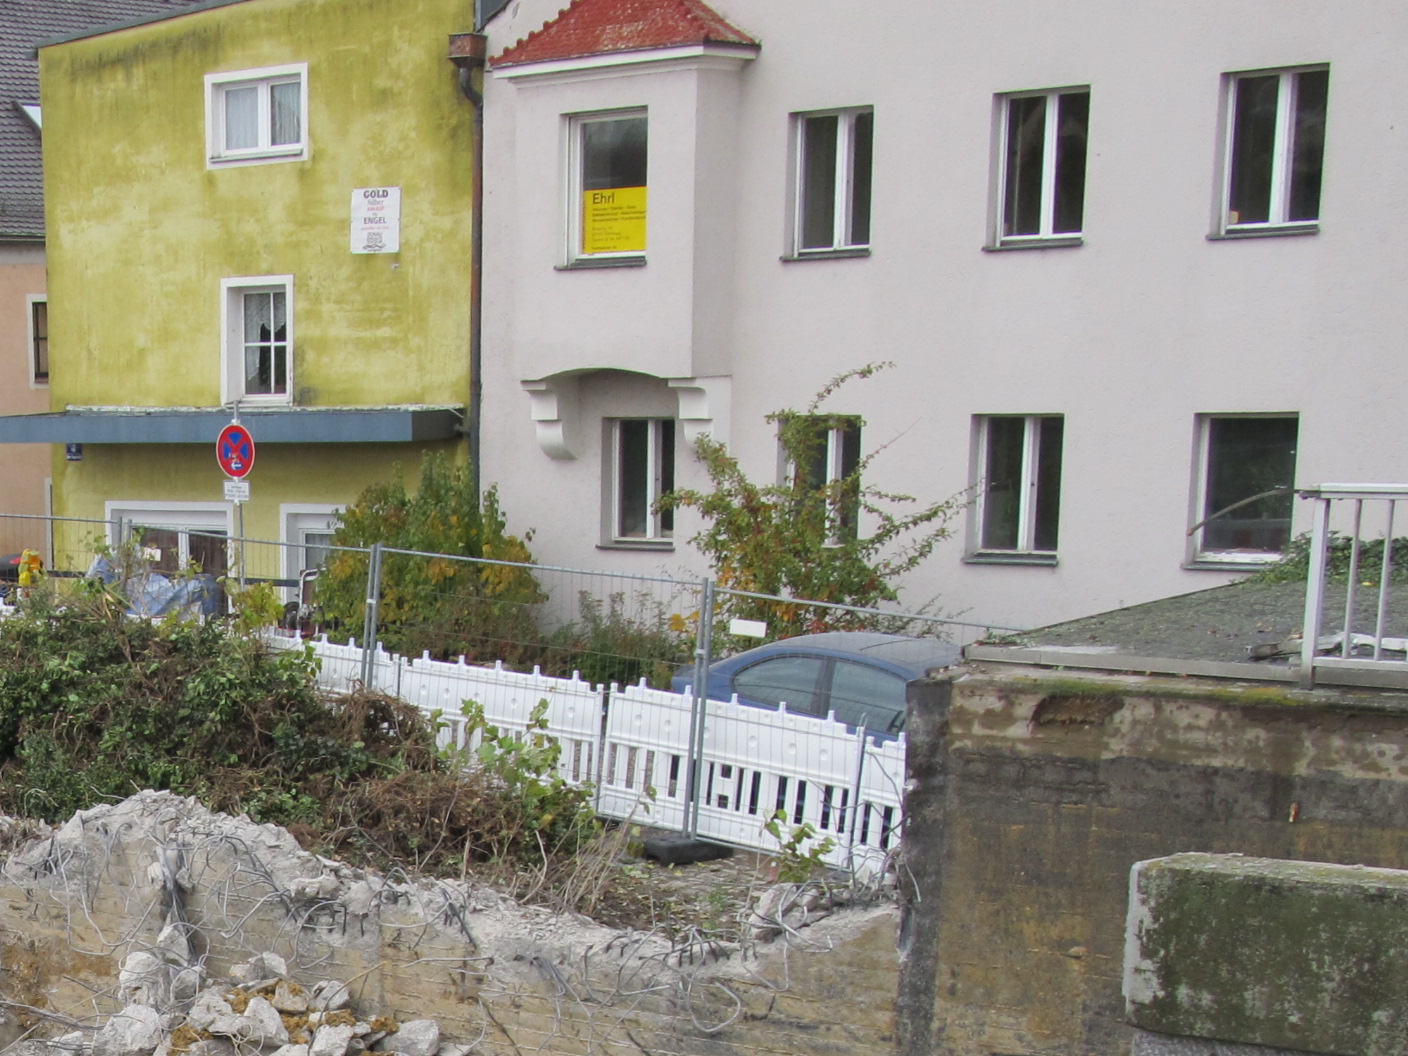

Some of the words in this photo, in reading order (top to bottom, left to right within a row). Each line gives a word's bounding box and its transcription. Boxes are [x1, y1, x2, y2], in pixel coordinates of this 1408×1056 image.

[363, 189, 389, 199] GOLD
[592, 192, 615, 205] Ehrl
[363, 217, 387, 225] ENGEL
